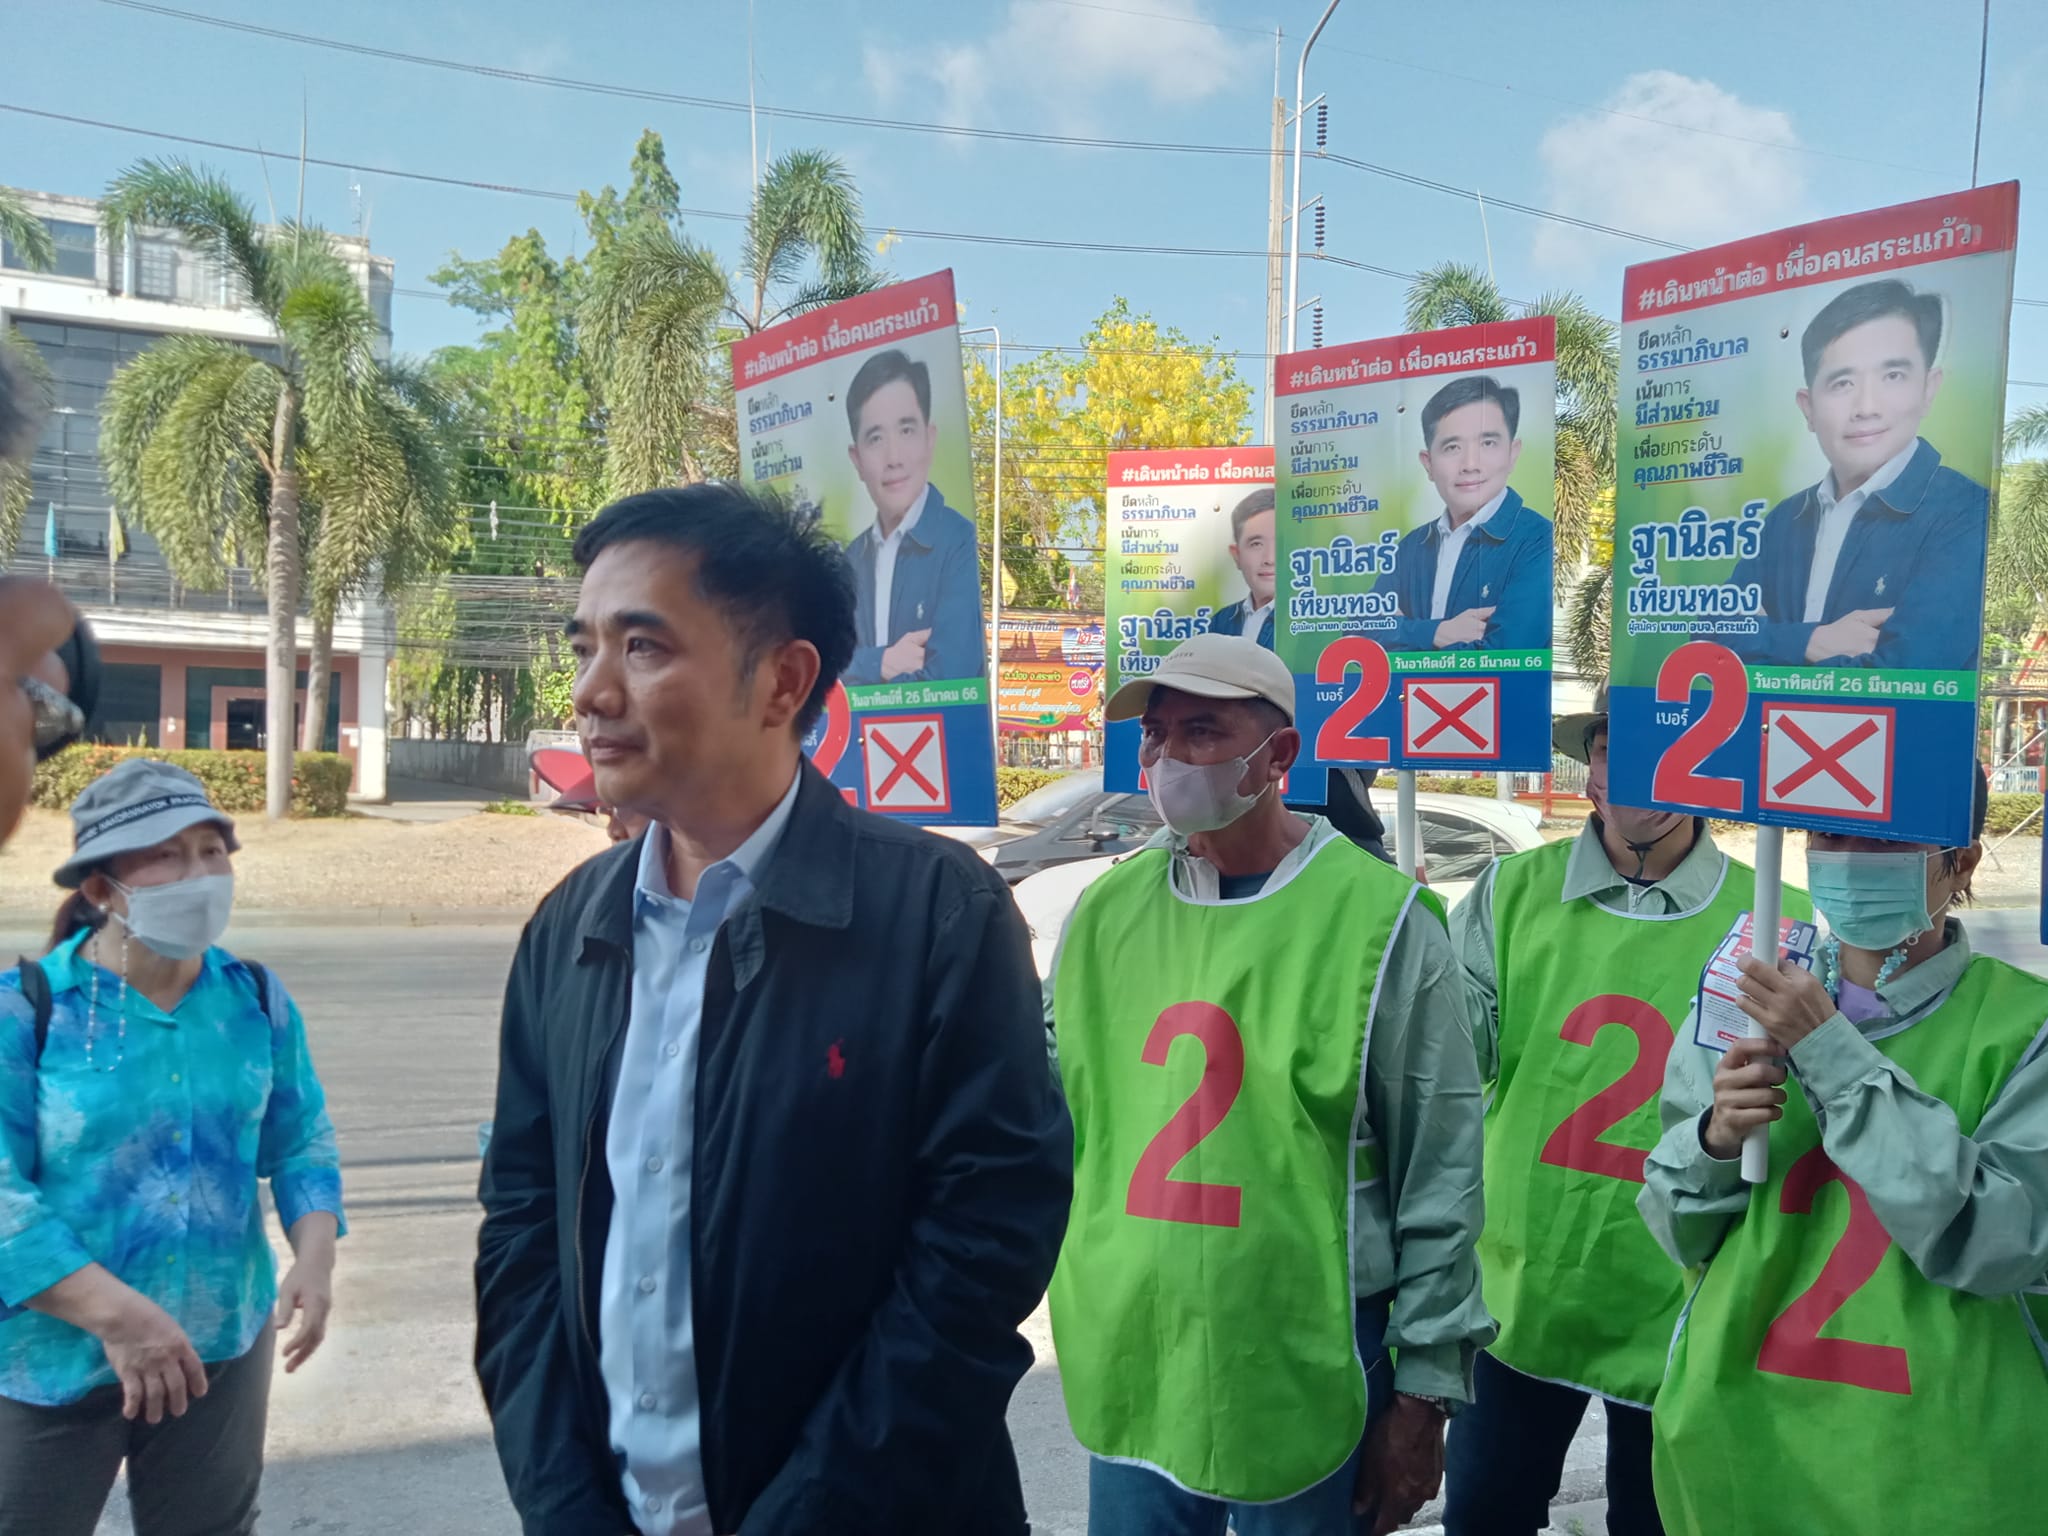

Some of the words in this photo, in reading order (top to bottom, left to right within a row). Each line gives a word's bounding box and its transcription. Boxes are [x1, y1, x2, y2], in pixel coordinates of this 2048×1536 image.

[1637, 264, 1768, 313] #เดินหน้าต่อ
[1776, 216, 1978, 283] เพื่อคนสระแก้ว
[744, 339, 817, 378] #เดินหน้าต่อ
[822, 298, 939, 350] เพื่อคนสระแก้ว
[1638, 325, 1692, 351] ยึดหลัก
[1289, 357, 1393, 388] #เดินหน้าต่อ
[1399, 336, 1538, 373] เพื่อคนสระแก้ว
[1638, 334, 1749, 371] ธรรมาภิบาล
[1636, 378, 1690, 402] เน้นการ
[750, 400, 813, 433] ธรรมาภิบาล
[1290, 402, 1334, 419] ยึดหลัก
[1290, 409, 1379, 434] ธรรมาภิบาล
[1635, 397, 1720, 427] มีส่วนร่วม
[1291, 440, 1335, 457] เน้นการ
[1634, 432, 1722, 460] เพื่อยกระดับ
[1121, 465, 1210, 483] #เดินหน้าต่อ
[1291, 454, 1359, 476] มีส่วนร่วม
[1633, 453, 1743, 487] คุณภาพชีวิต
[1122, 495, 1160, 507] ยึดหลัก
[1291, 480, 1362, 500] เพื่อยกระดับ
[1122, 504, 1197, 520] ธรรมาภิบาล
[1292, 495, 1379, 523] คุณภาพชีวิต
[1121, 526, 1159, 538] เน้นการ
[1632, 502, 1766, 575] ฐานิสร์
[1121, 540, 1179, 555] มีส่วนร่วม
[1290, 530, 1399, 589] ฐานิสร์
[1120, 562, 1182, 576] เพื่อยกระดับ
[1120, 574, 1196, 594] คุณภาพชีวิต
[1628, 575, 1762, 615] เทียนทอง
[1290, 588, 1397, 618] เทียนทอง
[1119, 607, 1212, 649] ฐานิสร์
[1628, 618, 1657, 637] ผู้สมัคร
[1659, 620, 1686, 634] นายก
[1689, 620, 1714, 634] อบจ.
[1716, 615, 1759, 634] สระแก้ว
[1394, 653, 1456, 670] วันอาทิตย์ที่
[1459, 657, 1476, 669] 26
[1480, 655, 1520, 669] มีนาคม
[1524, 656, 1543, 668] 66
[905, 690, 920, 704] 26
[923, 687, 959, 704] มีนาคม
[962, 687, 978, 701] 66
[1316, 687, 1344, 702] เบอร์
[1753, 670, 1835, 692] วันอาทิตย์ที่
[1839, 677, 1862, 693] 26
[1867, 675, 1926, 696] มีนาคม
[1933, 680, 1959, 697] 66
[1315, 636, 1391, 762] 2
[1651, 640, 1749, 813] 2
[1656, 708, 1690, 727] เบอร์
[1787, 929, 1801, 945] 2
[1539, 993, 1676, 1183] 2
[1126, 1001, 1245, 1228] 2
[1757, 1145, 1911, 1396] 2
